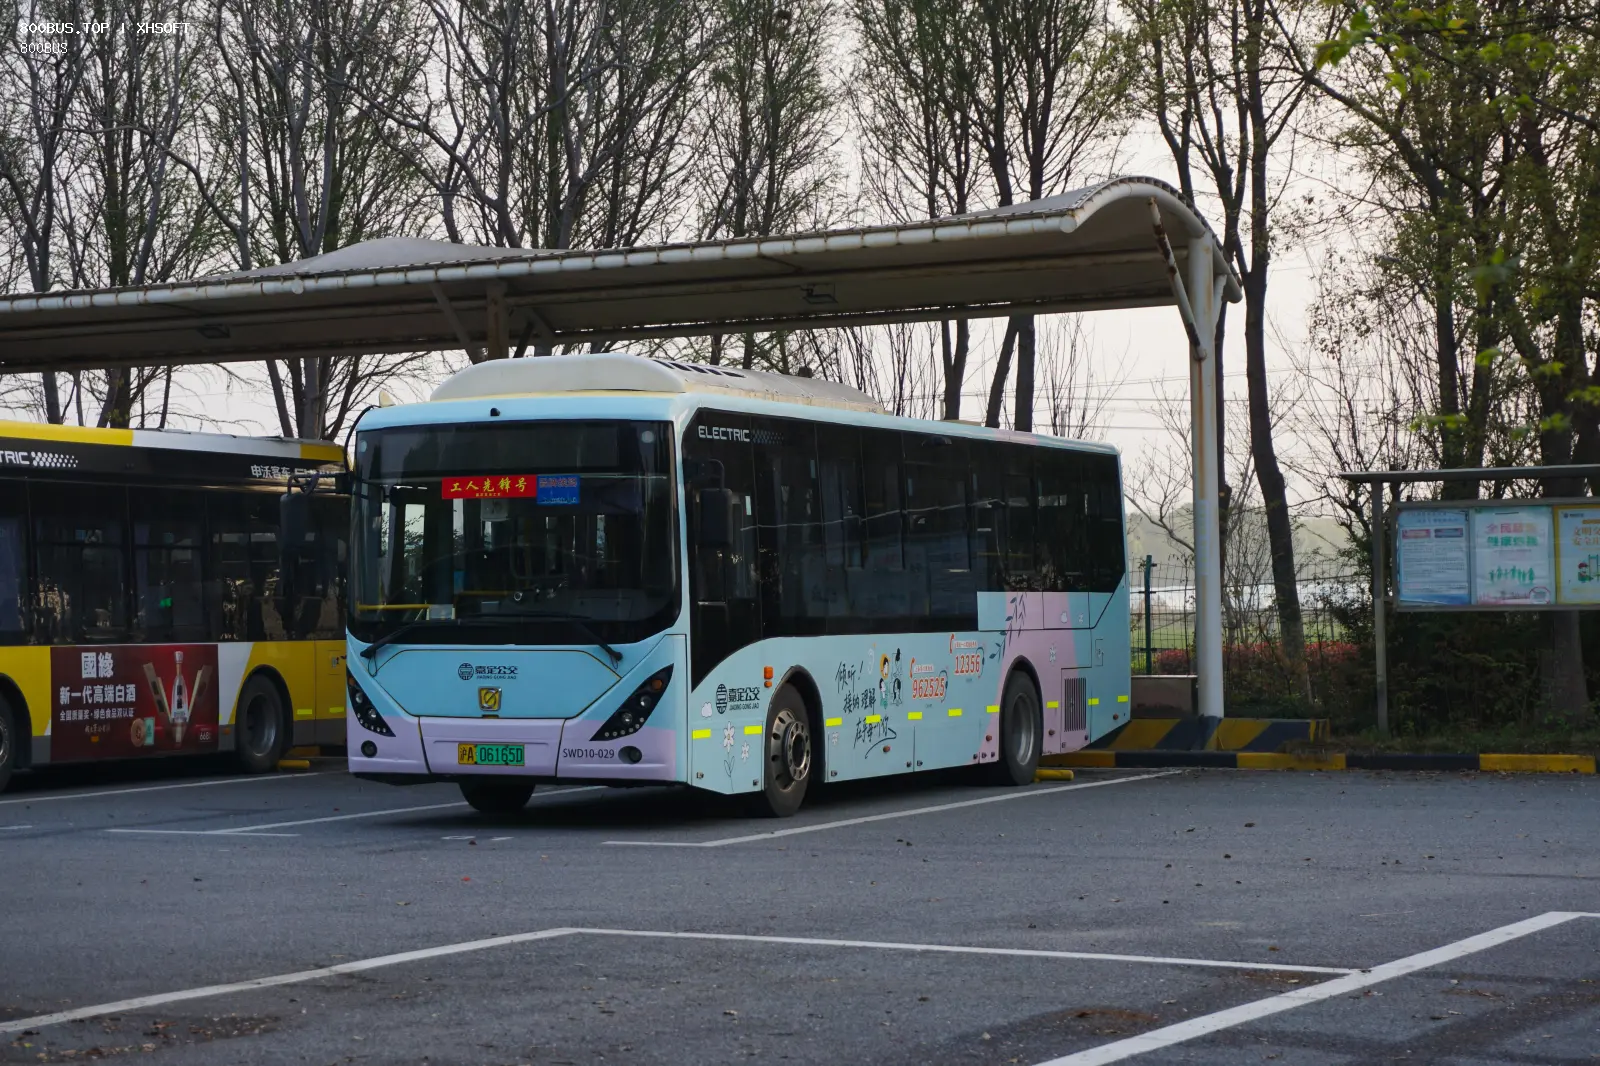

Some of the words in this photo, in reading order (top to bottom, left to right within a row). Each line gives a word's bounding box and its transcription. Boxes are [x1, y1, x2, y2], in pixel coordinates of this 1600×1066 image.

[698, 425, 750, 442] ELECTRIC
[251, 464, 291, 479] 申沃客车
[450, 476, 527, 493] 工人先锋号
[475, 665, 518, 675] 嘉定公交
[955, 654, 981, 674] 12356
[60, 684, 136, 705] 新一代高端白酒
[728, 686, 760, 702] 嘉定公交
[912, 677, 945, 699] 962525
[563, 748, 615, 759] SWD10-029
